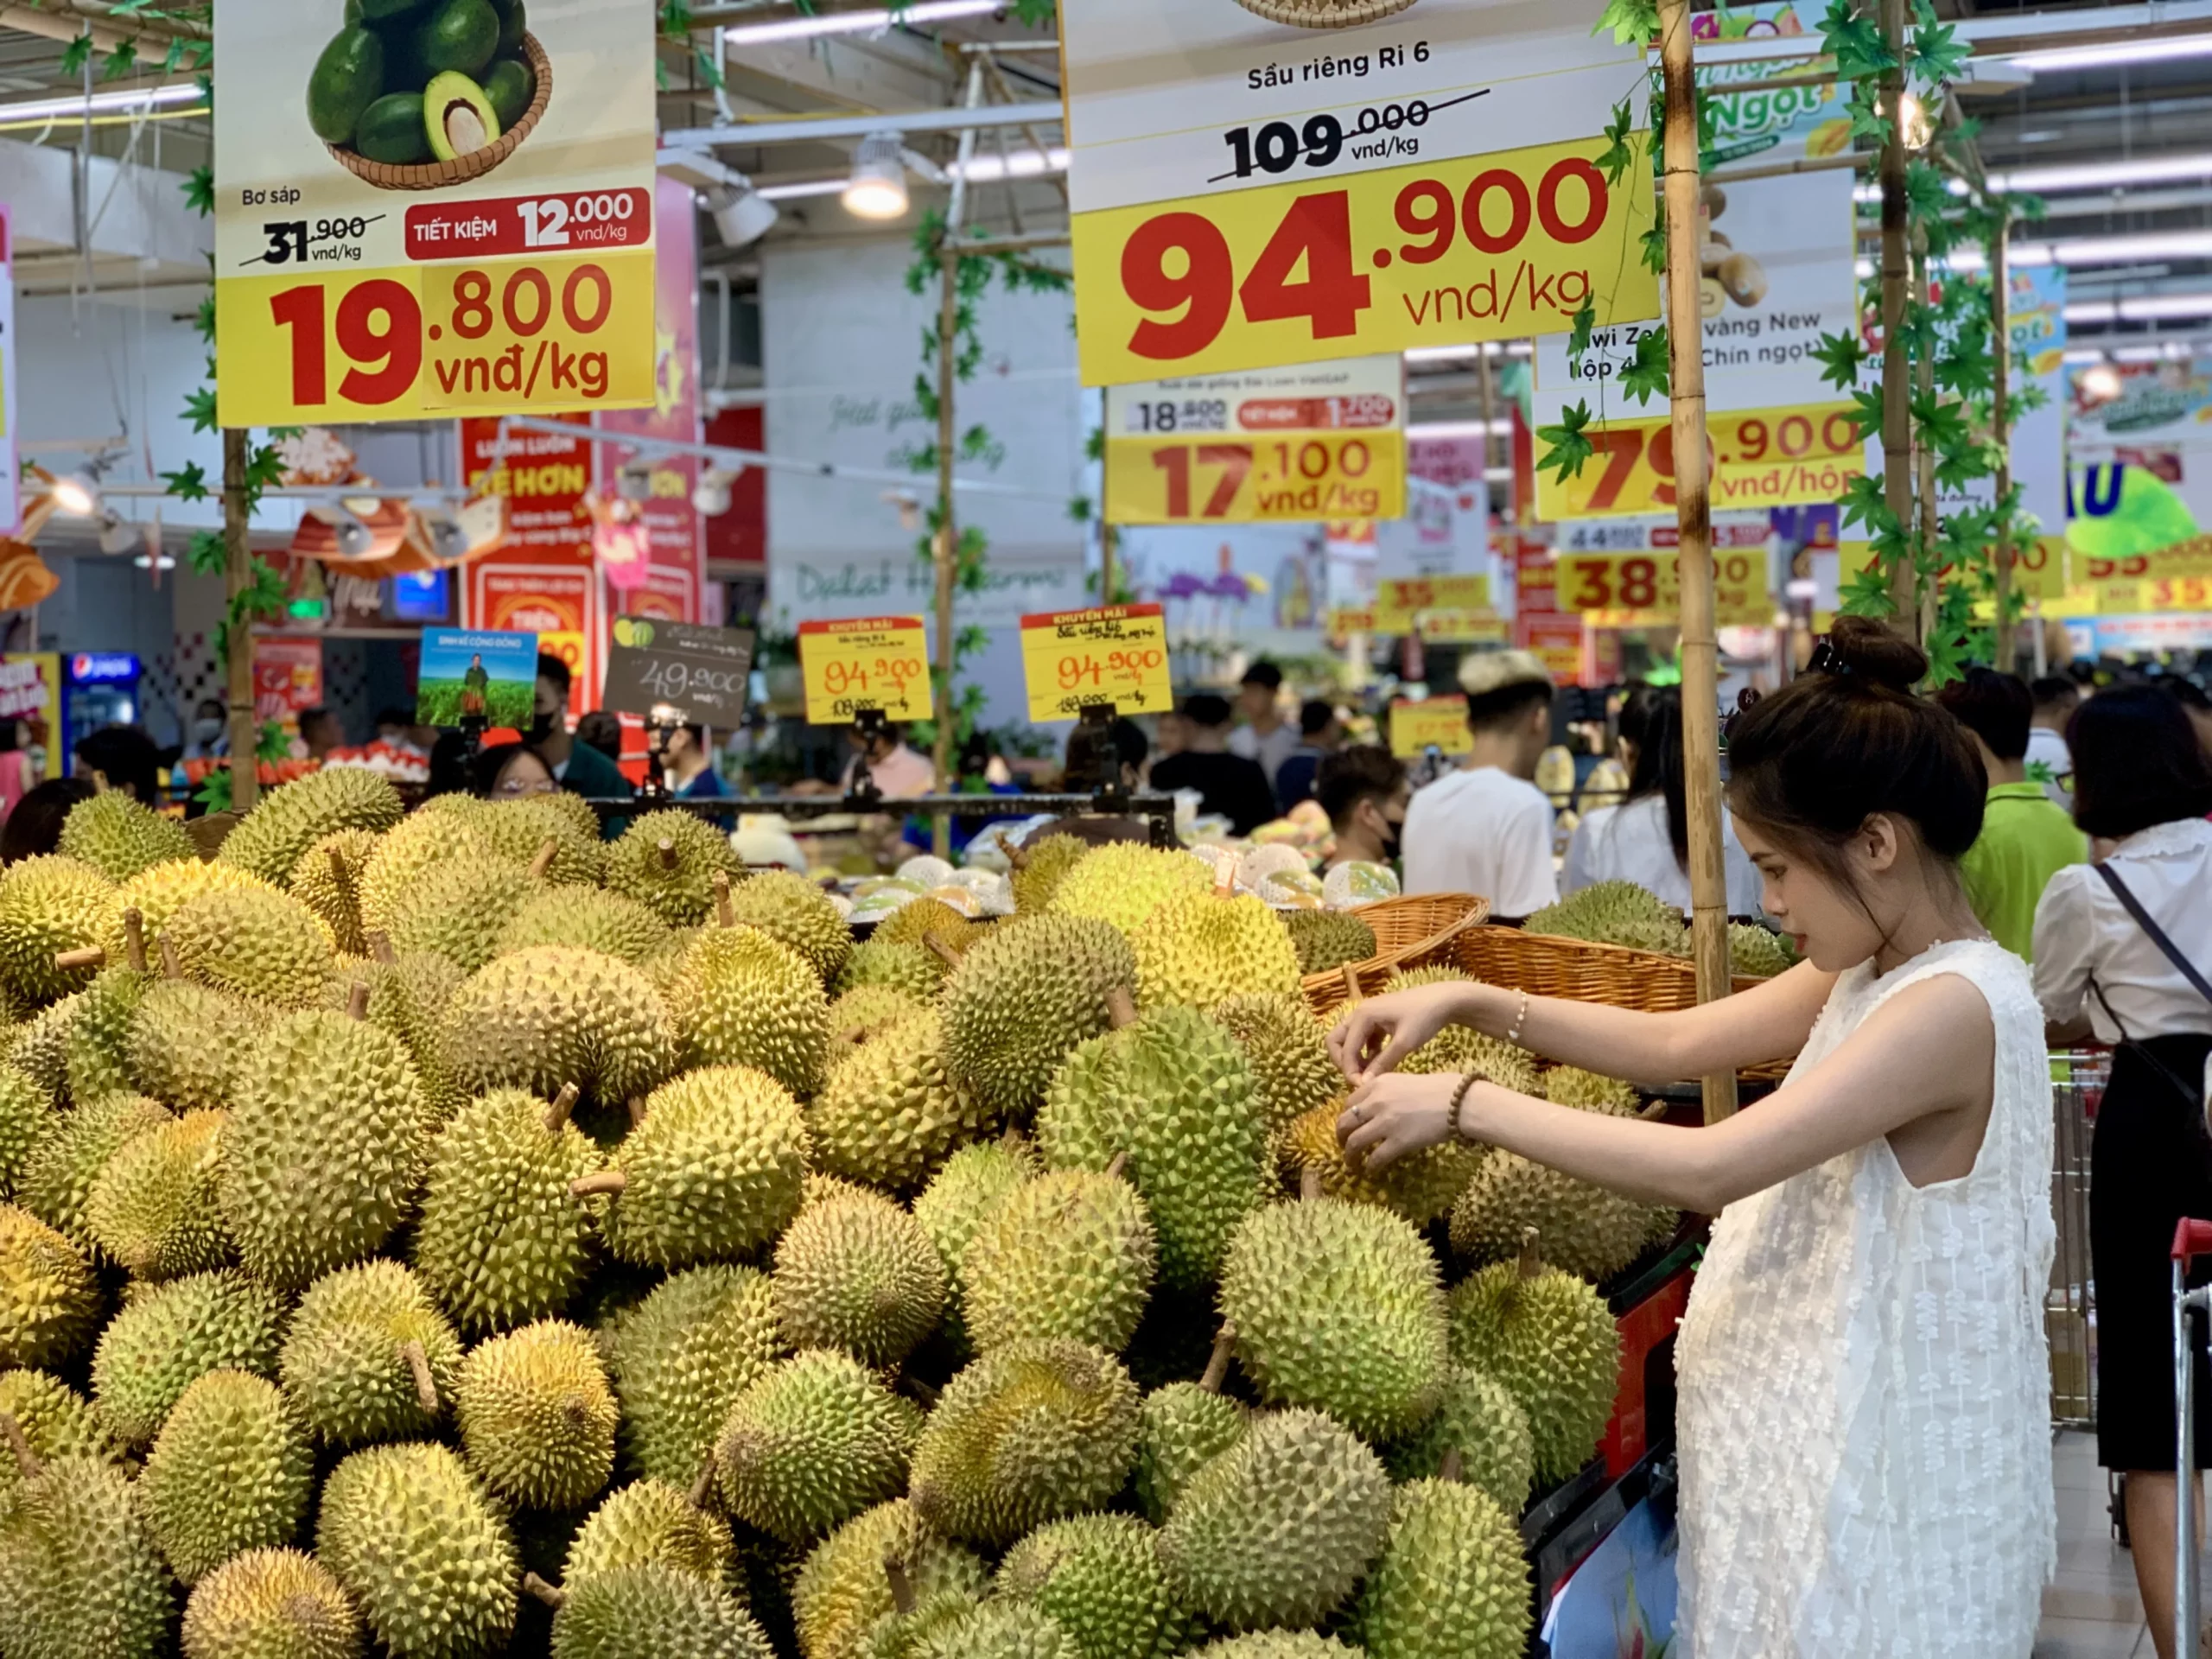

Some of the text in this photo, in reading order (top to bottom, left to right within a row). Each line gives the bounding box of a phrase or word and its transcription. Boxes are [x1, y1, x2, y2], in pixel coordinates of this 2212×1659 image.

[1247, 41, 1430, 90] Sầu riêng Ri 6
[1351, 135, 1420, 161] vnd/kg
[242, 185, 302, 207] Bơ sáp
[414, 214, 498, 243] TIẾT KIỆM
[575, 223, 627, 242] vnd/kg
[311, 243, 362, 262] vnd/kg
[1402, 259, 1592, 327] vnd/kg
[1704, 312, 1821, 338] vàng New
[434, 340, 608, 399] vnđ/kg
